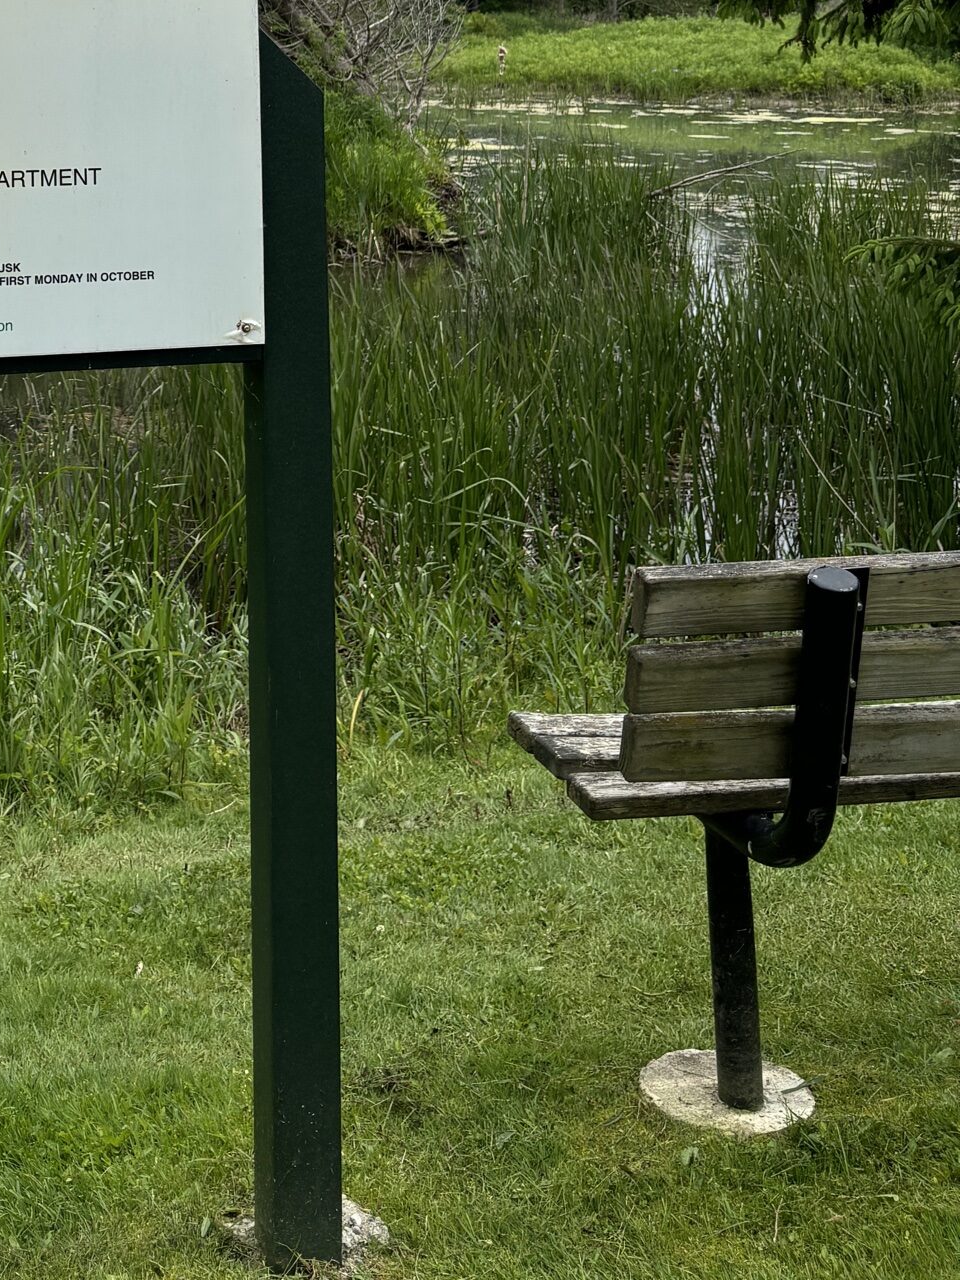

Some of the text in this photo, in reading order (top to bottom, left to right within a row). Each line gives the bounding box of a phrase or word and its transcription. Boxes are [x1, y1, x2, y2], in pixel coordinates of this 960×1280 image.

[0, 276, 31, 286] FIRST
[35, 273, 83, 284] MONDAY
[87, 273, 97, 282] IN
[101, 271, 154, 281] OCTOBER
